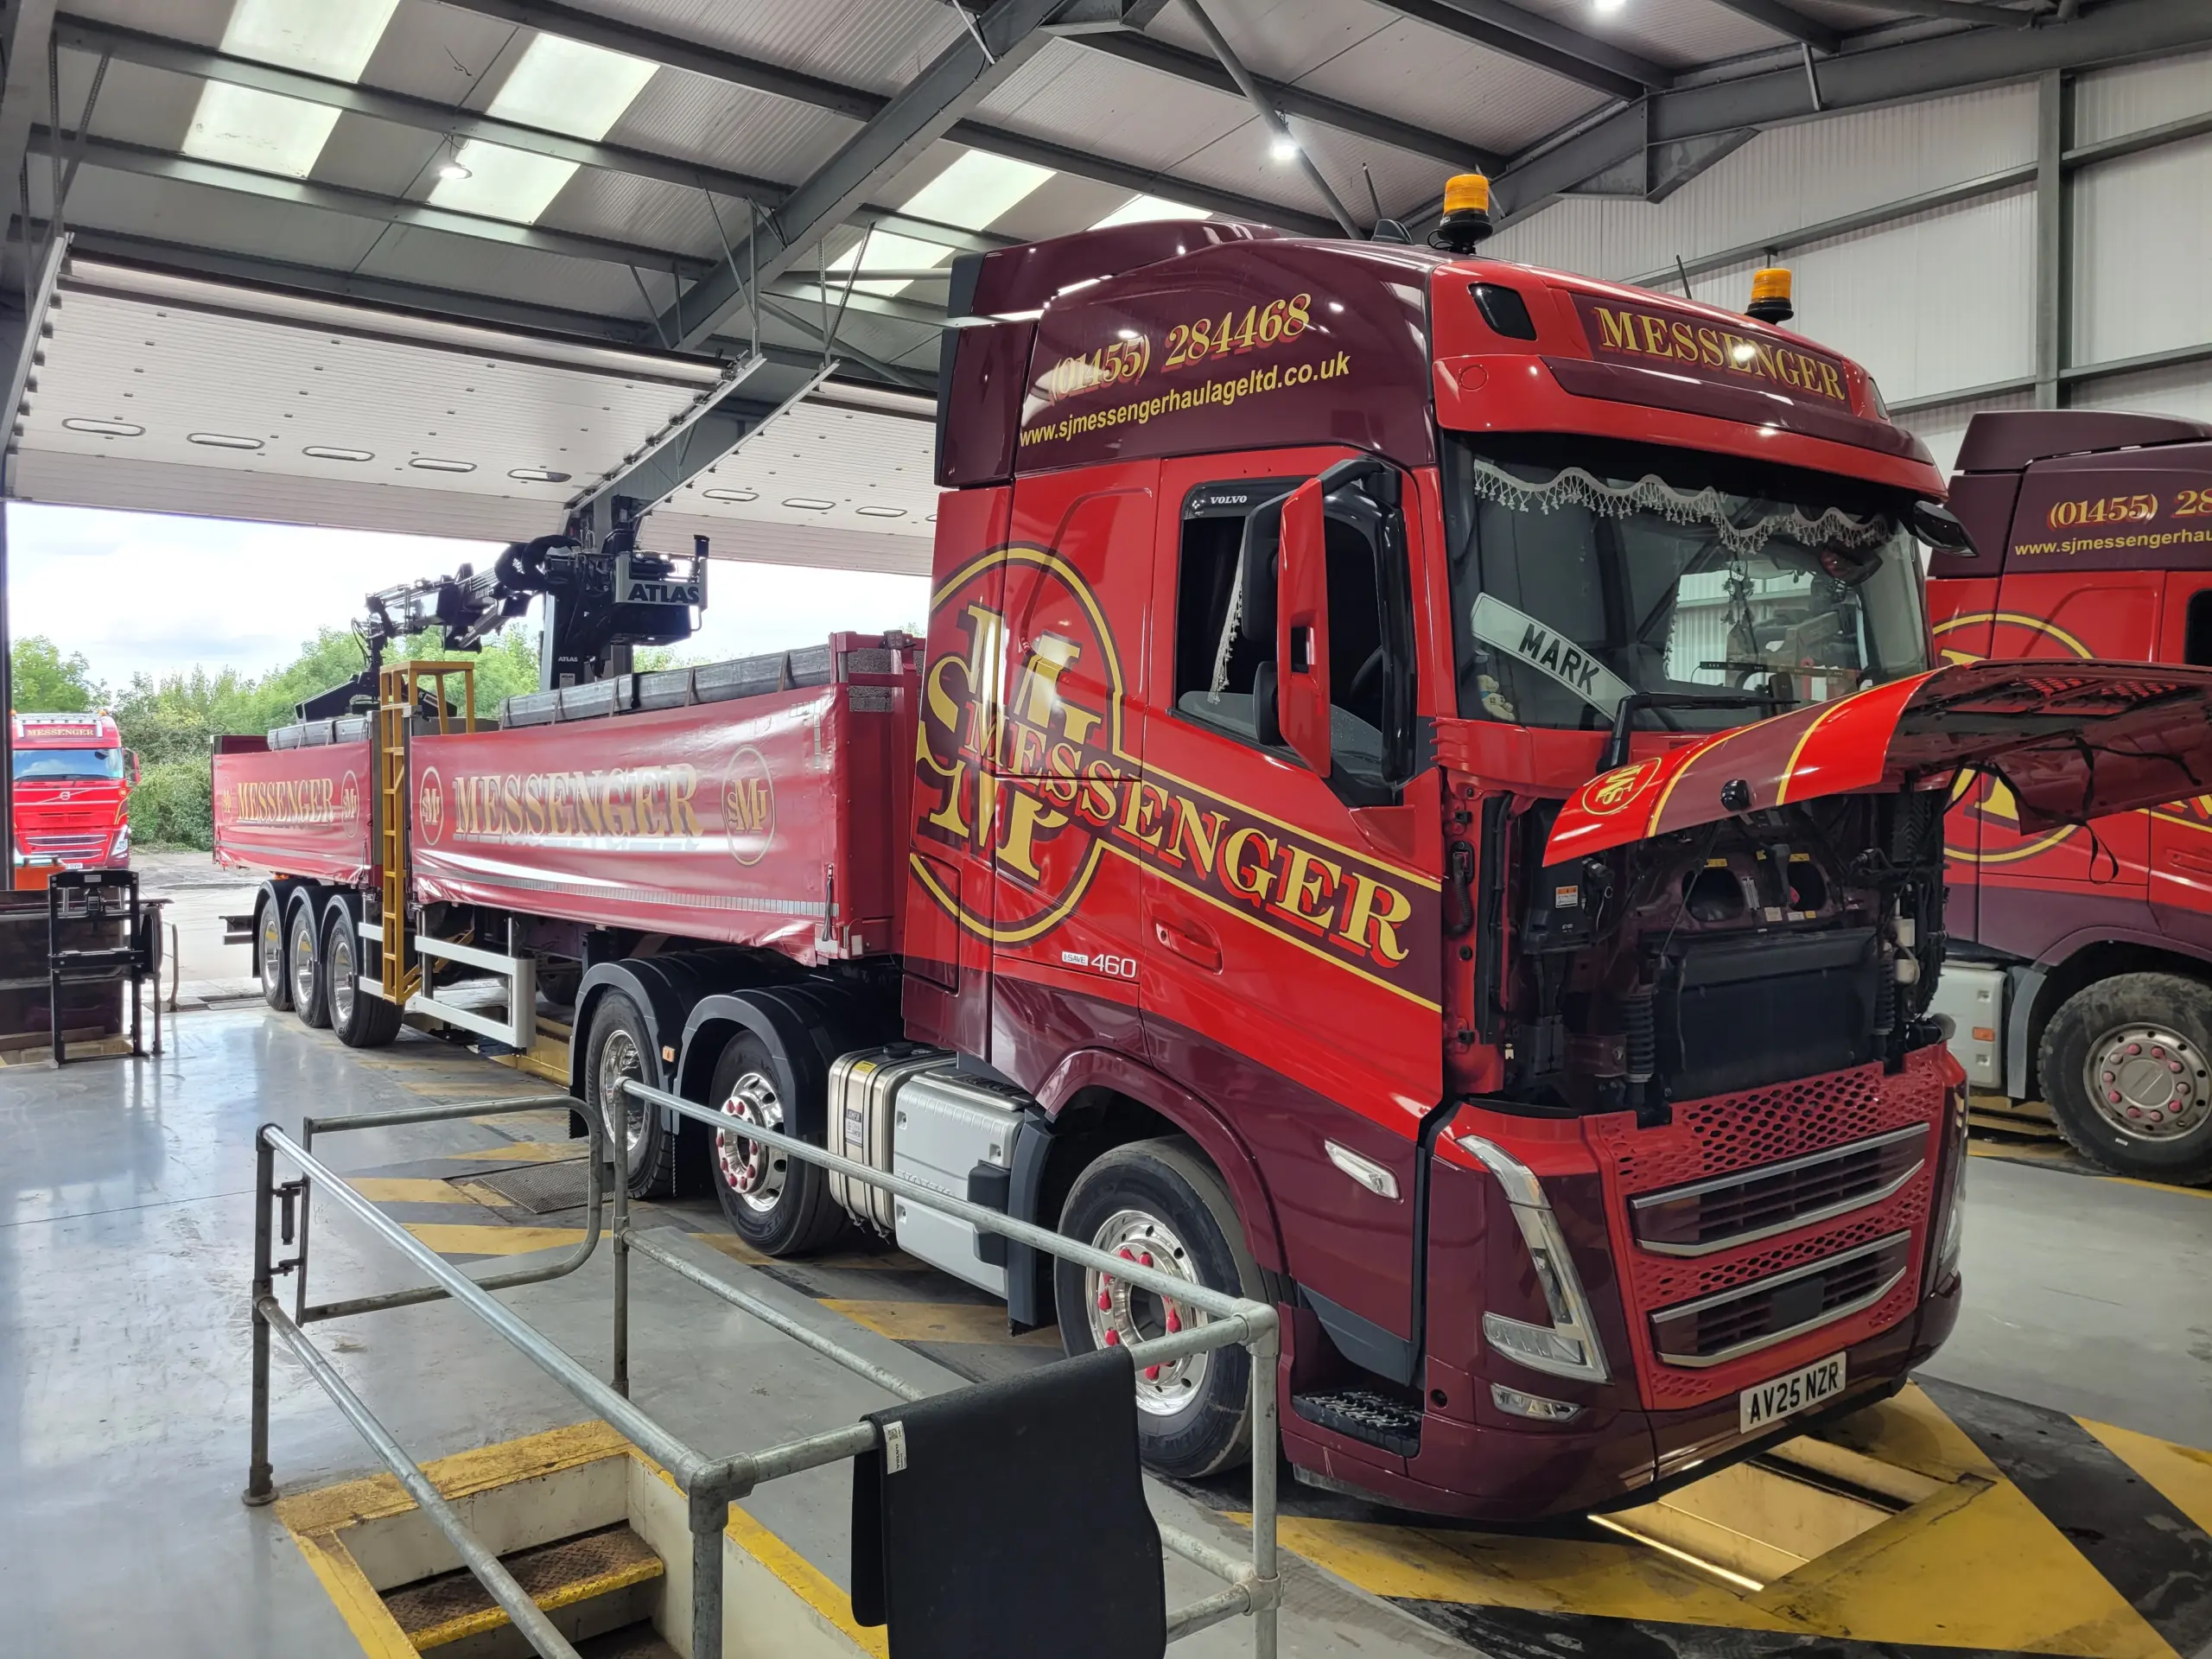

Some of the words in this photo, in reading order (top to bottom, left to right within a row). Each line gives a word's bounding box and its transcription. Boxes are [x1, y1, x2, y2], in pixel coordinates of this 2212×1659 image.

[1049, 333, 1151, 406] (01455)
[1161, 293, 1313, 372] 284468
[1594, 306, 1847, 401] MESSENGER
[1020, 351, 1350, 447] www.sjmessengerhaulageltd.co.uk
[1211, 495, 1248, 505] VOLVO
[2050, 493, 2158, 529] (01455)
[627, 583, 700, 604] ATLAS
[1517, 622, 1600, 696] MARK
[237, 779, 336, 824] MESSENGER
[453, 762, 704, 851] MESSENGER
[959, 700, 1413, 959] MESSENGER
[1090, 954, 1136, 978] 460
[1750, 1377, 1800, 1424] AV25
[1806, 1361, 1839, 1402] NZR
